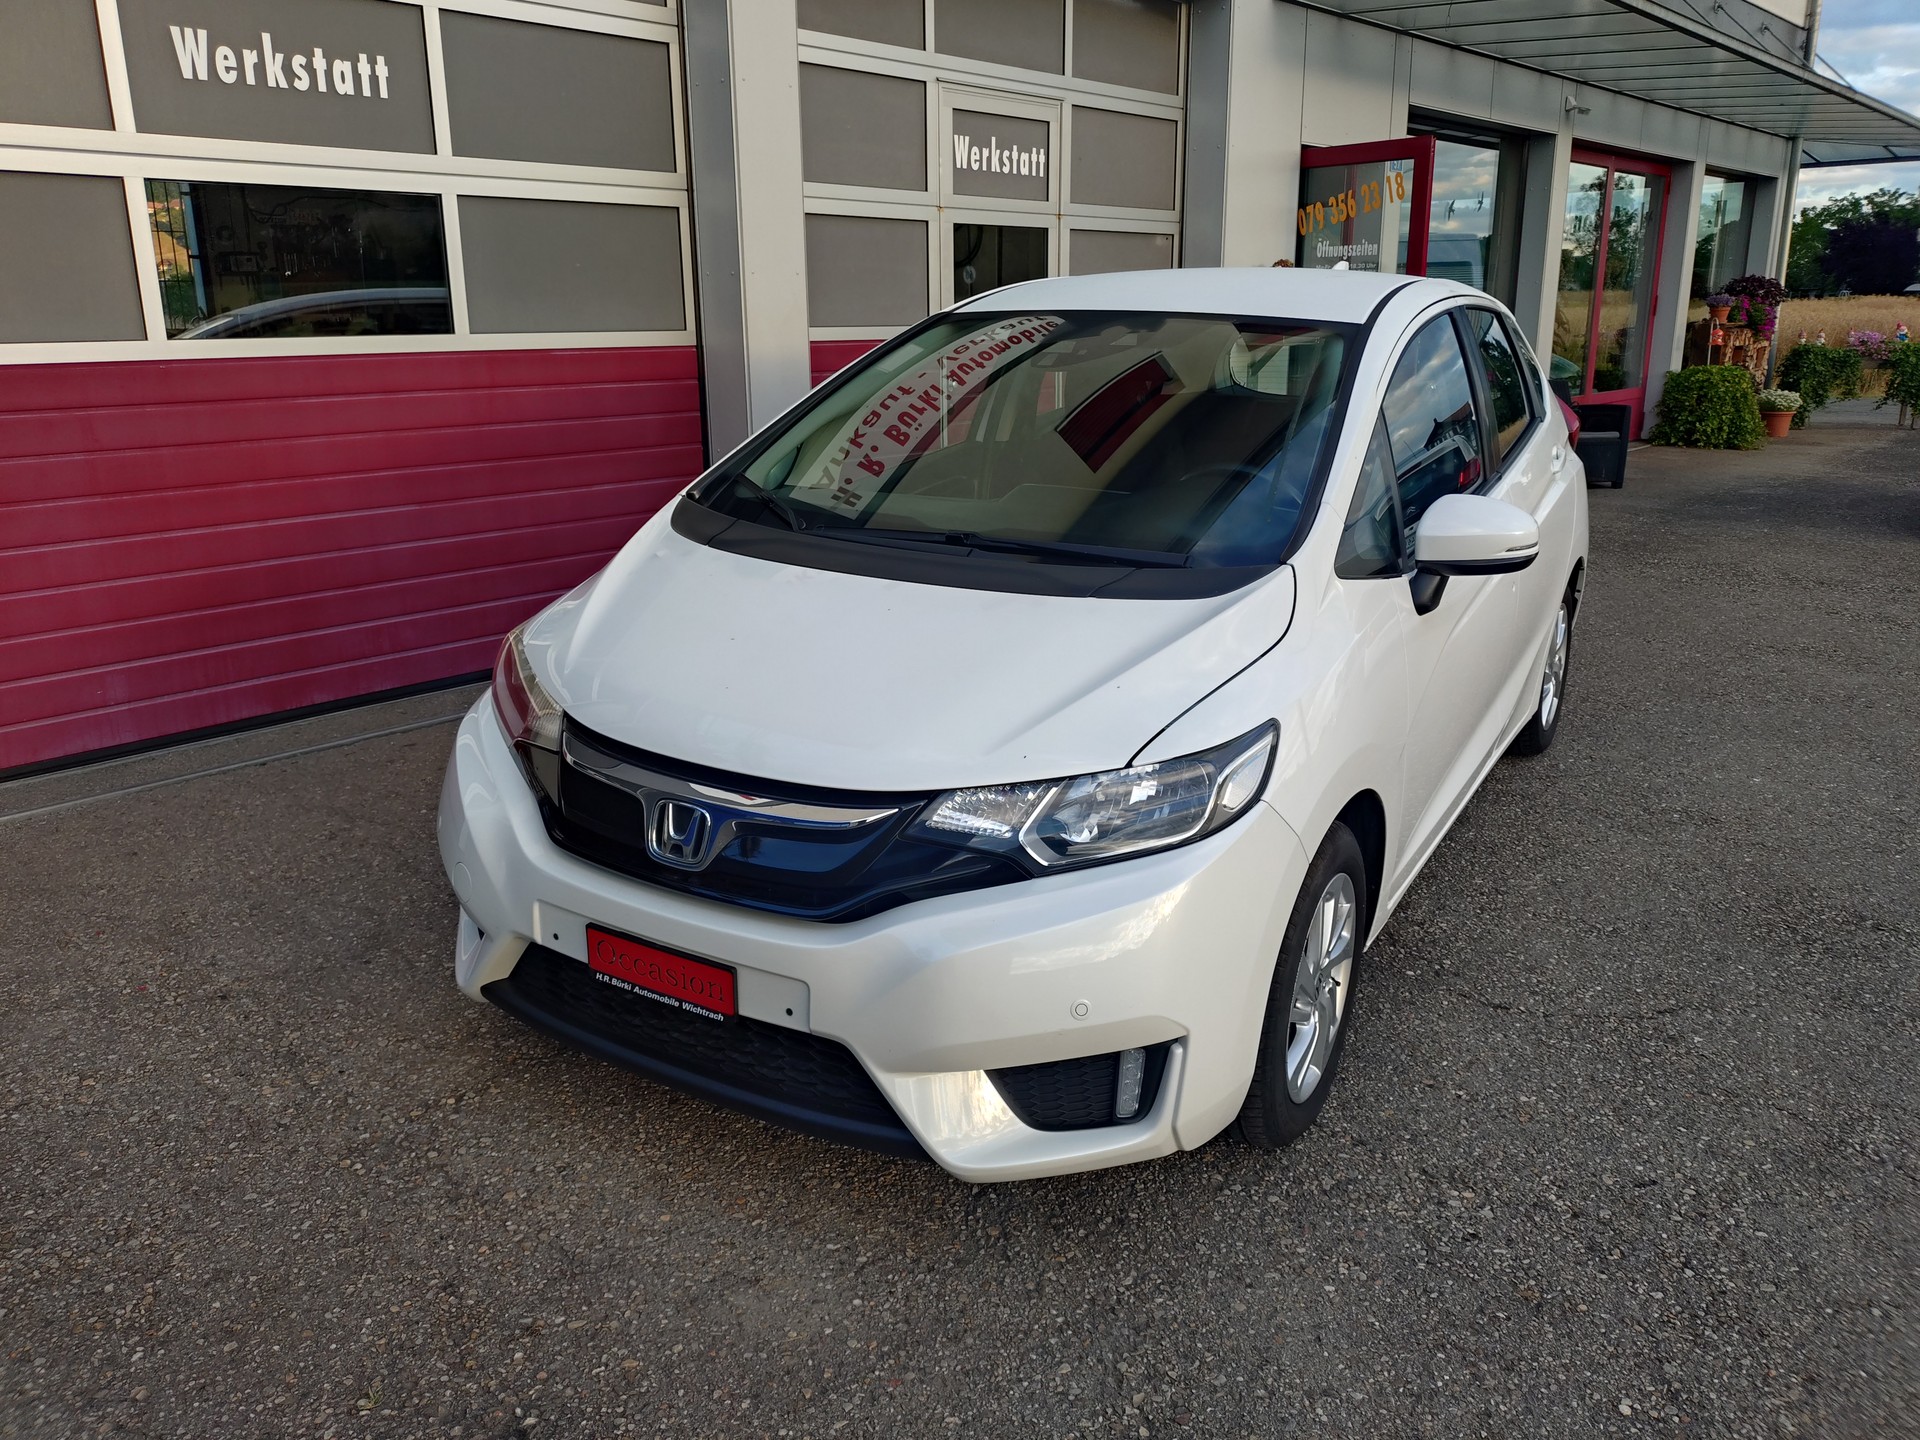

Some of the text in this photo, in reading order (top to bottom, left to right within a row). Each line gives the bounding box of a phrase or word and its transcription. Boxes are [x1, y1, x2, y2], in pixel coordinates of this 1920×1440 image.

[169, 25, 390, 100] Werkstatt
[953, 134, 1047, 179] Werkstatt
[1297, 172, 1406, 236] 079 356 23 18
[1316, 238, 1378, 260] Öffnungszeiten
[596, 939, 726, 1003] Occasion
[633, 986, 680, 1007] Automobile
[682, 1001, 725, 1022] Wichtrach
